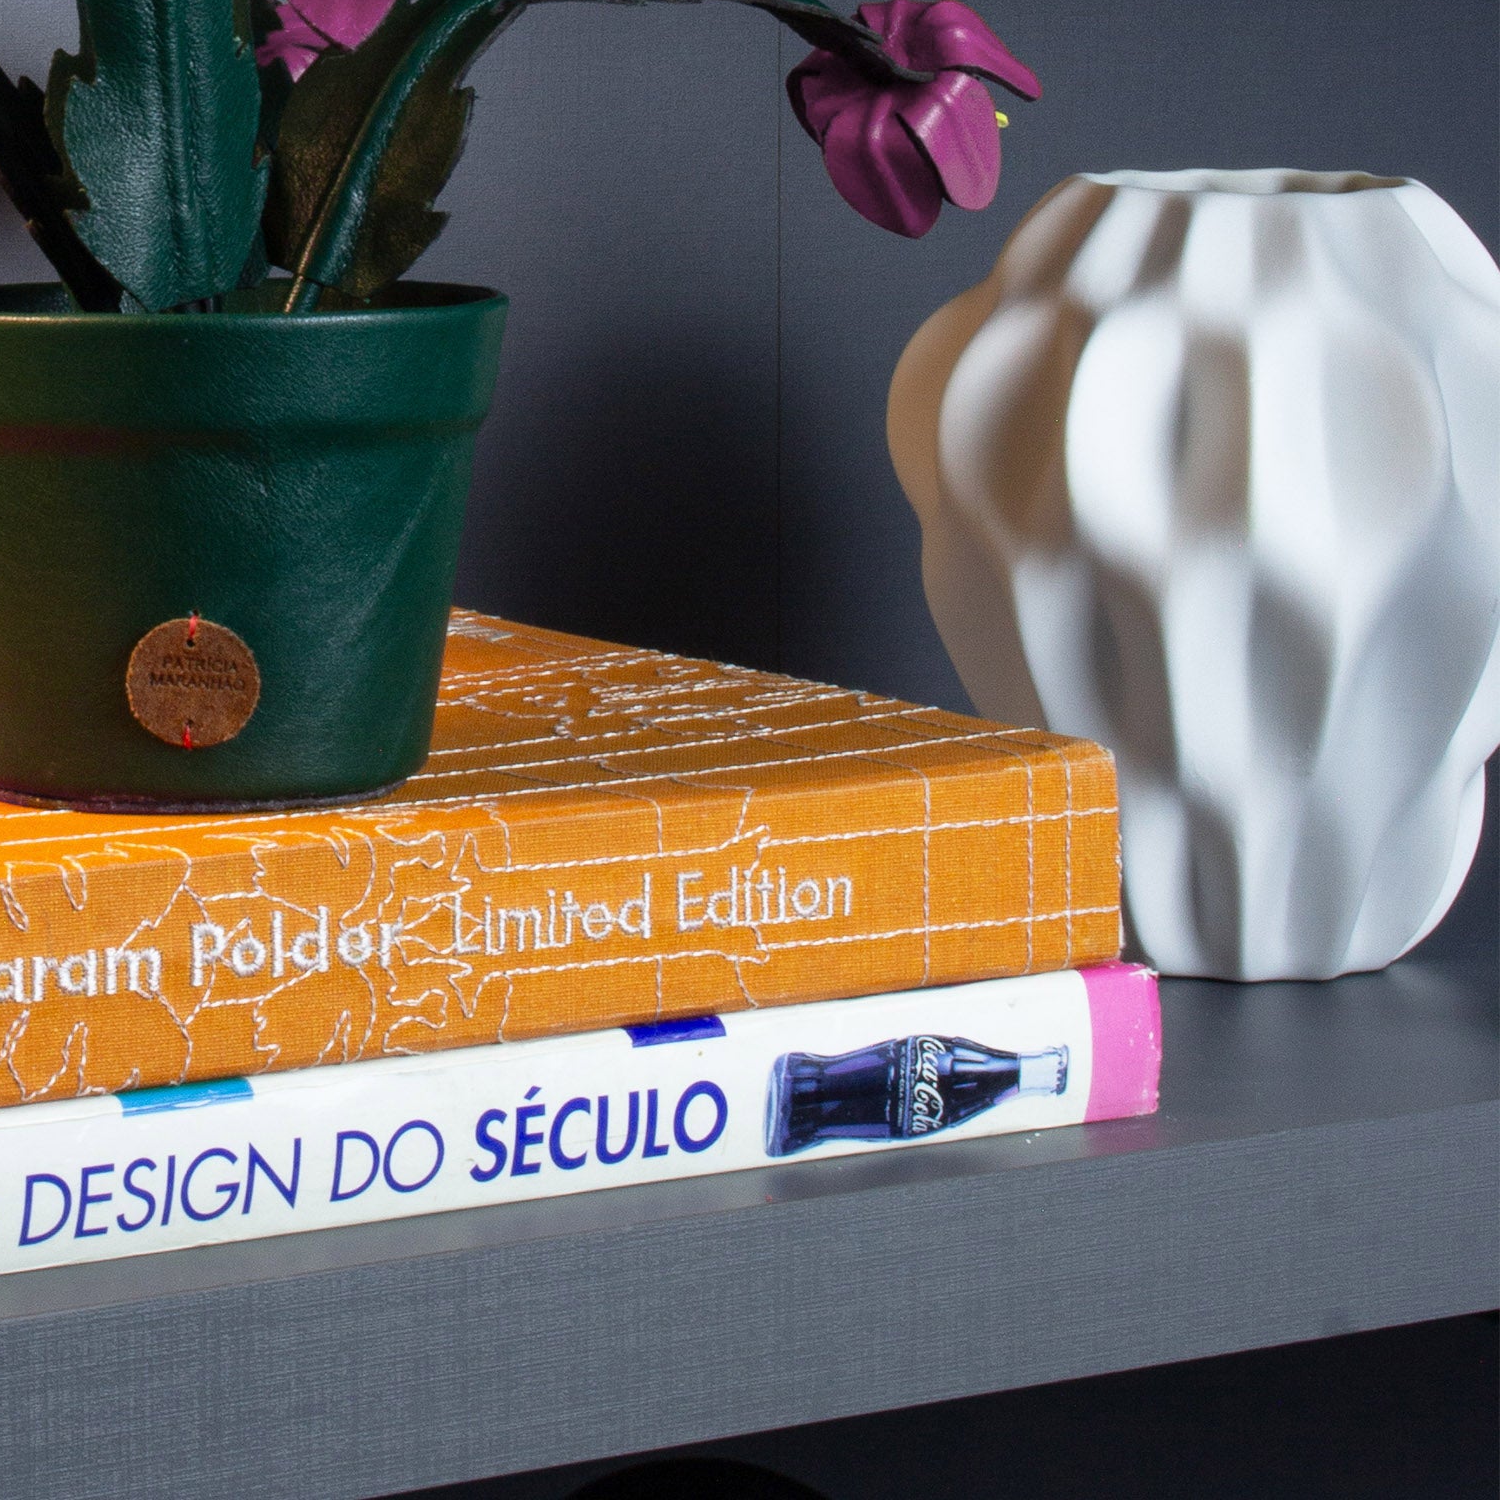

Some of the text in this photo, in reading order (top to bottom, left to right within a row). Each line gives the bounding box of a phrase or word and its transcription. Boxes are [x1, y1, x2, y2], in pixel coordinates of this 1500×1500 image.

[190, 905, 404, 987] Polder
[452, 872, 651, 956] Limited
[676, 865, 852, 933] Edition
[18, 1136, 302, 1247] DESIGN
[329, 1118, 445, 1203] DO
[469, 1080, 728, 1183] SÉCULO
